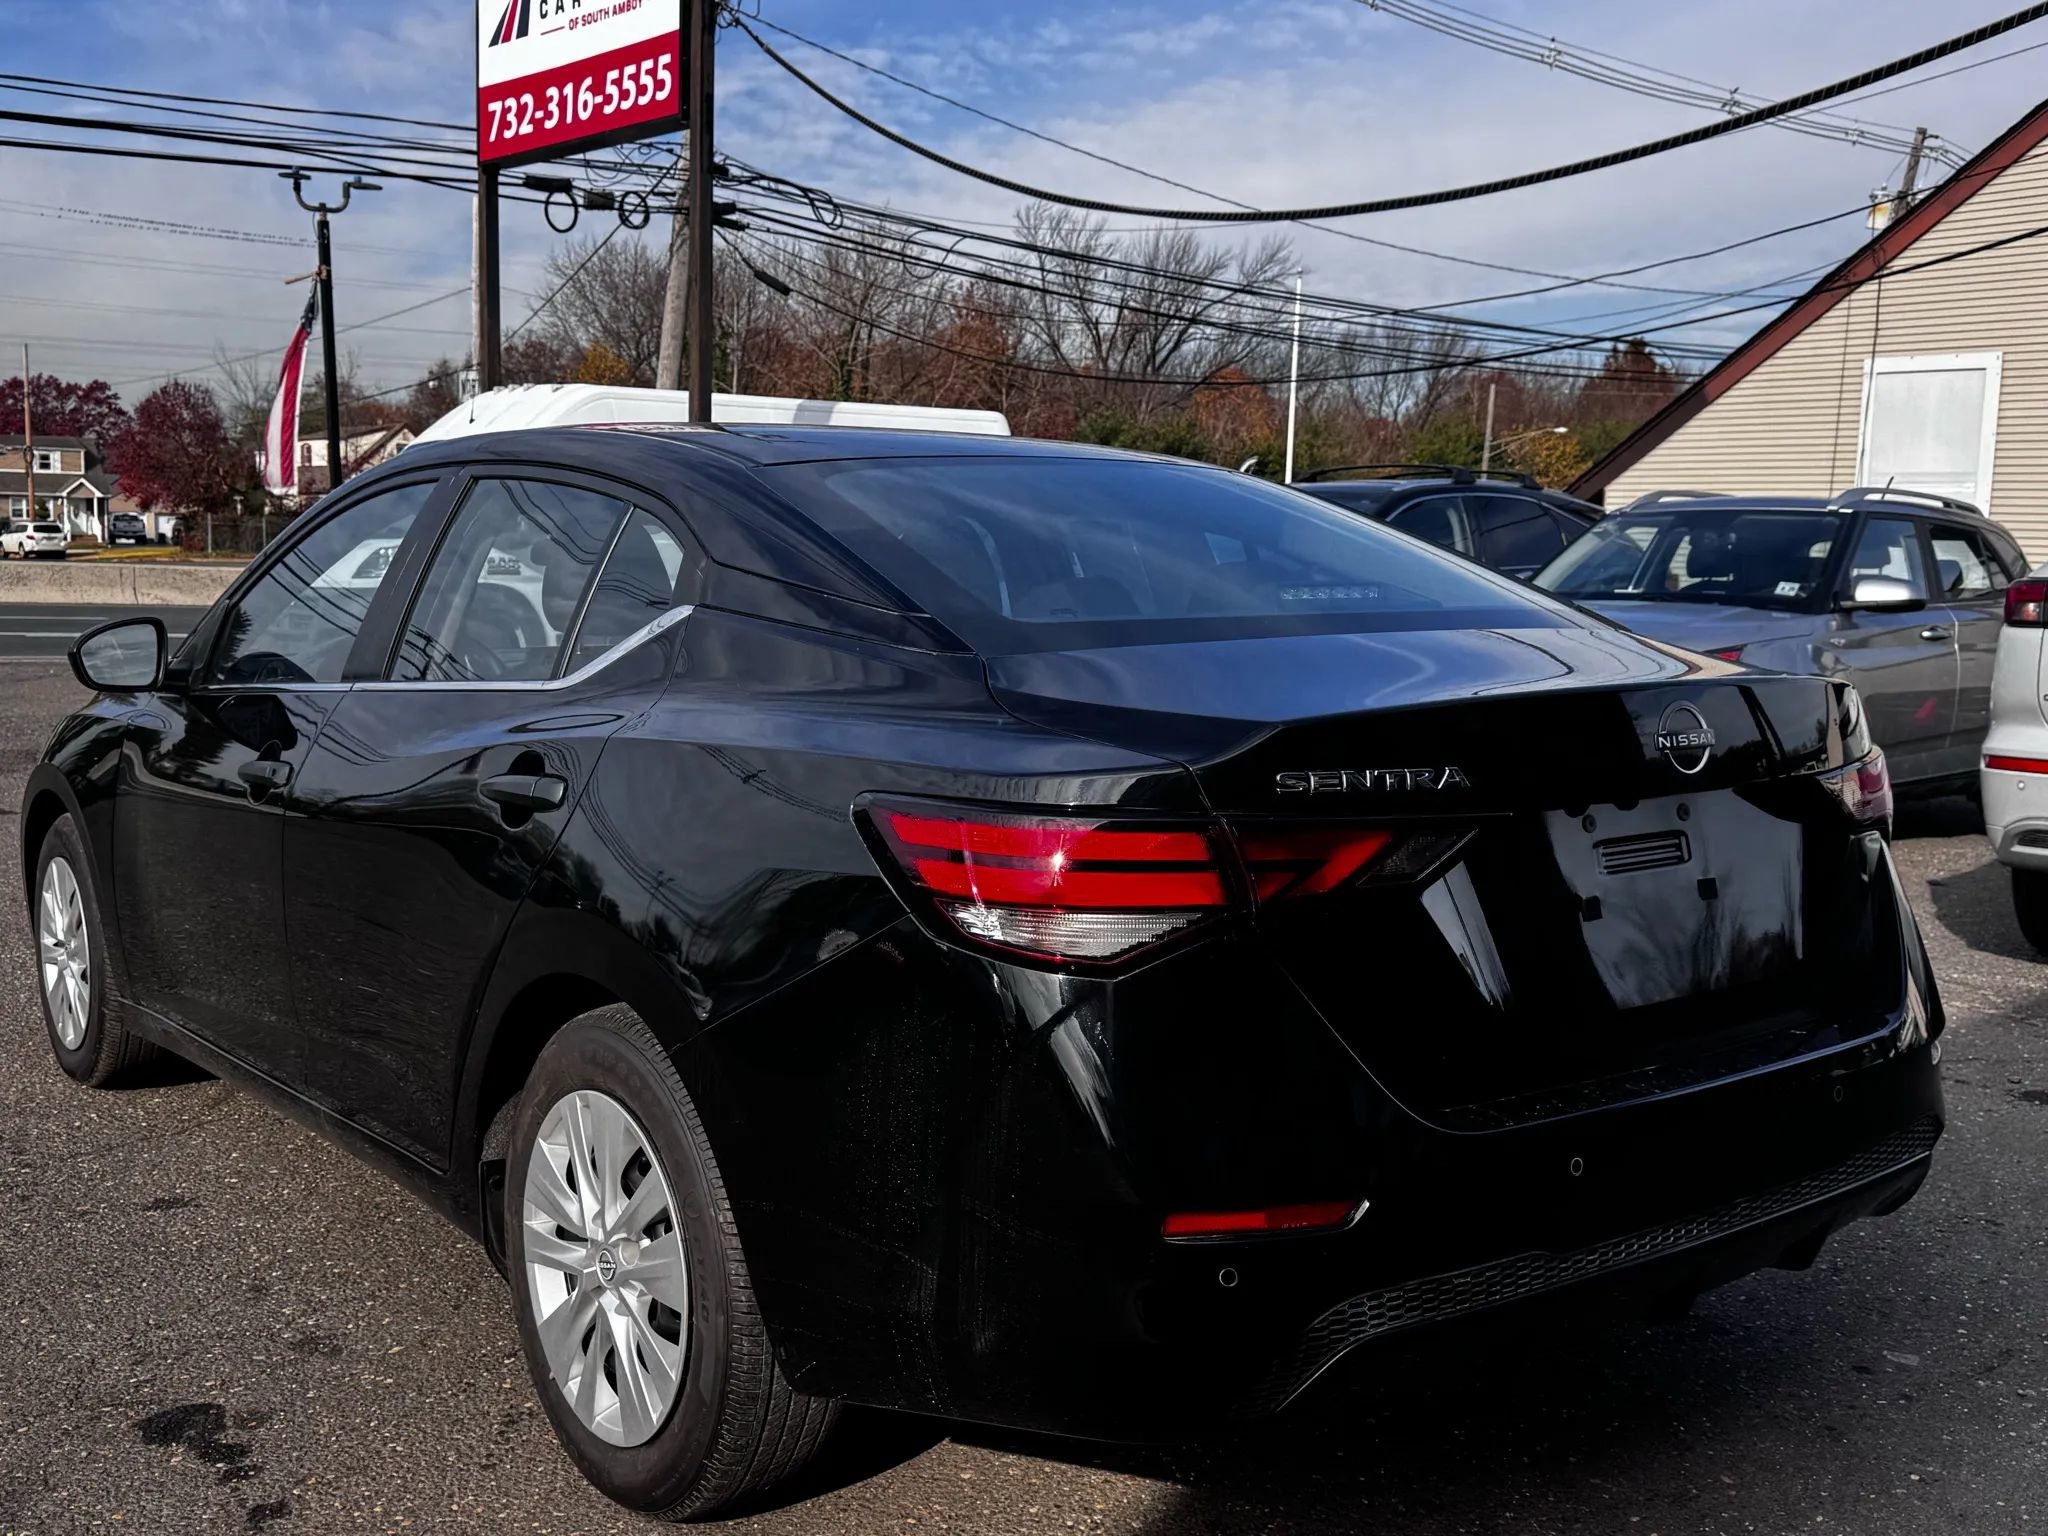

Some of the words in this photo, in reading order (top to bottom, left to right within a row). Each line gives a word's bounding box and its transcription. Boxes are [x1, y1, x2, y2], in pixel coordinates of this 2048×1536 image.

[568, 17, 579, 31] OF
[582, 6, 610, 27] SOUTH
[612, 0, 642, 17] AMBOY
[487, 53, 673, 143] 732-316-5555
[1658, 732, 1716, 748] NISSAN
[1275, 766, 1471, 795] SENTRA
